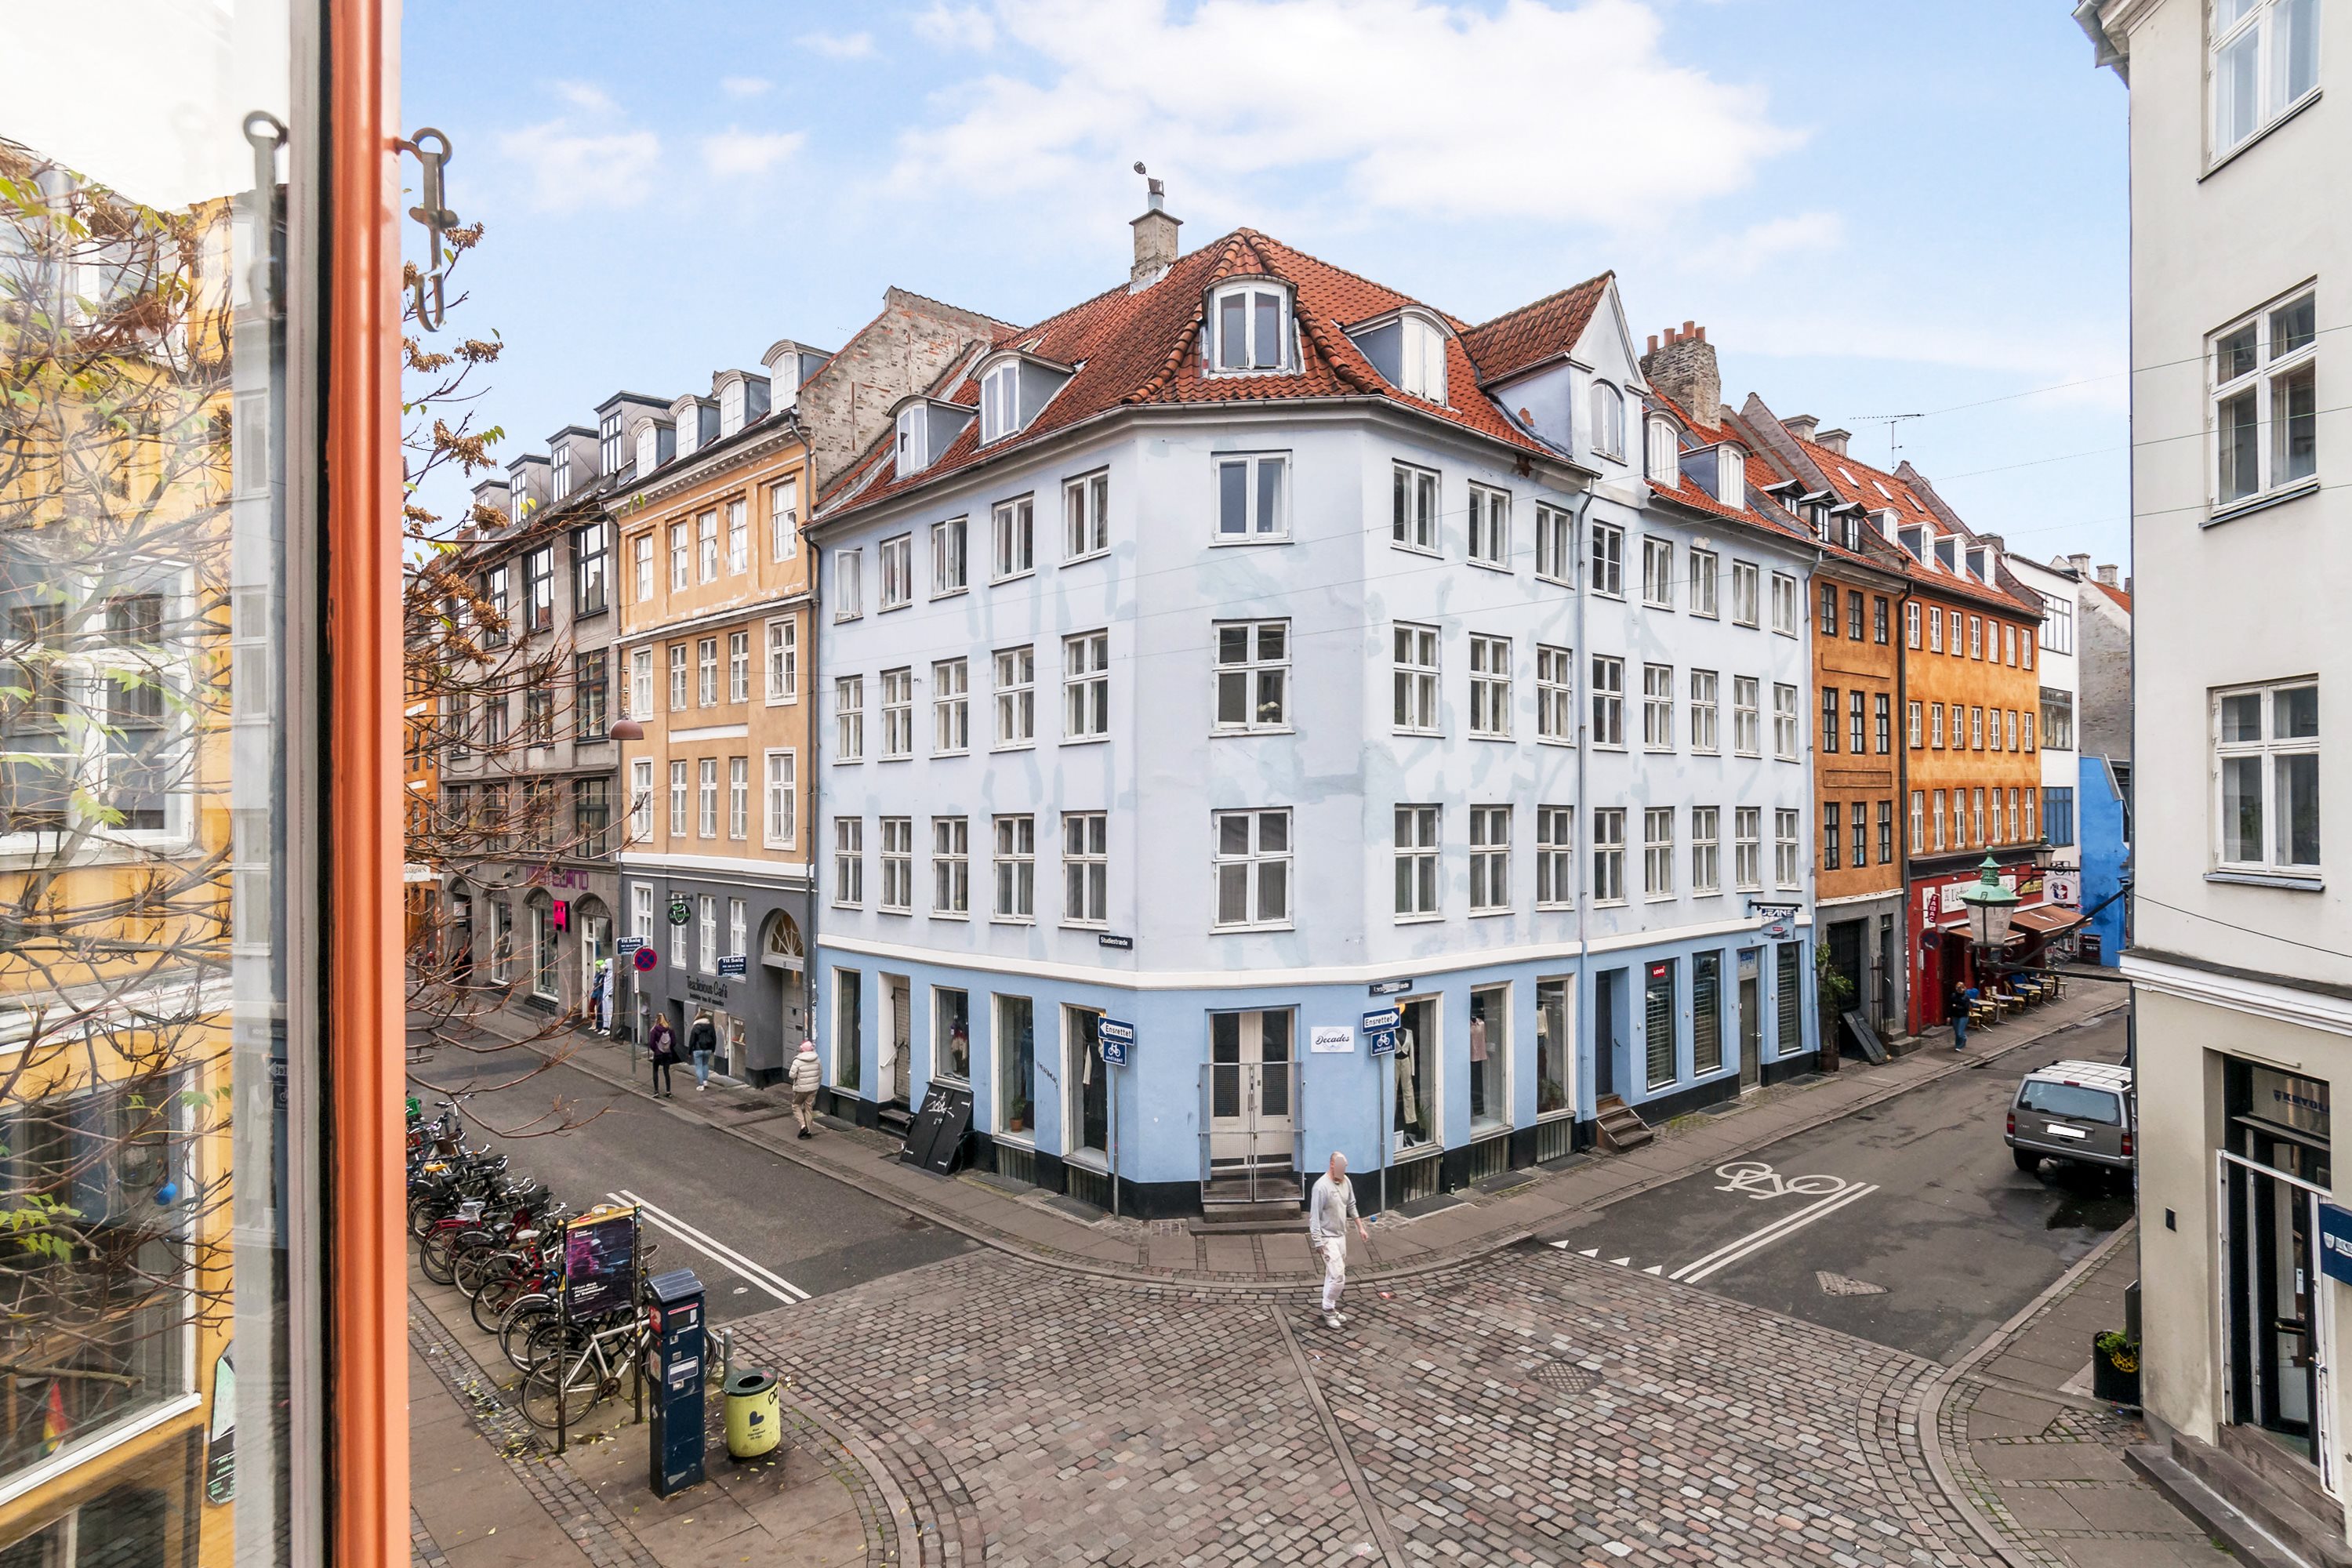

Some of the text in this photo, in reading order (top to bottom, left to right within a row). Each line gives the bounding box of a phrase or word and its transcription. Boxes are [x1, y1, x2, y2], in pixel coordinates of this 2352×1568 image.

[1929, 895, 1937, 921] TABAC
[1365, 1015, 1393, 1026] Ensrettet
[1105, 1024, 1131, 1038] Ensrettet
[1315, 1033, 1350, 1045] Decades
